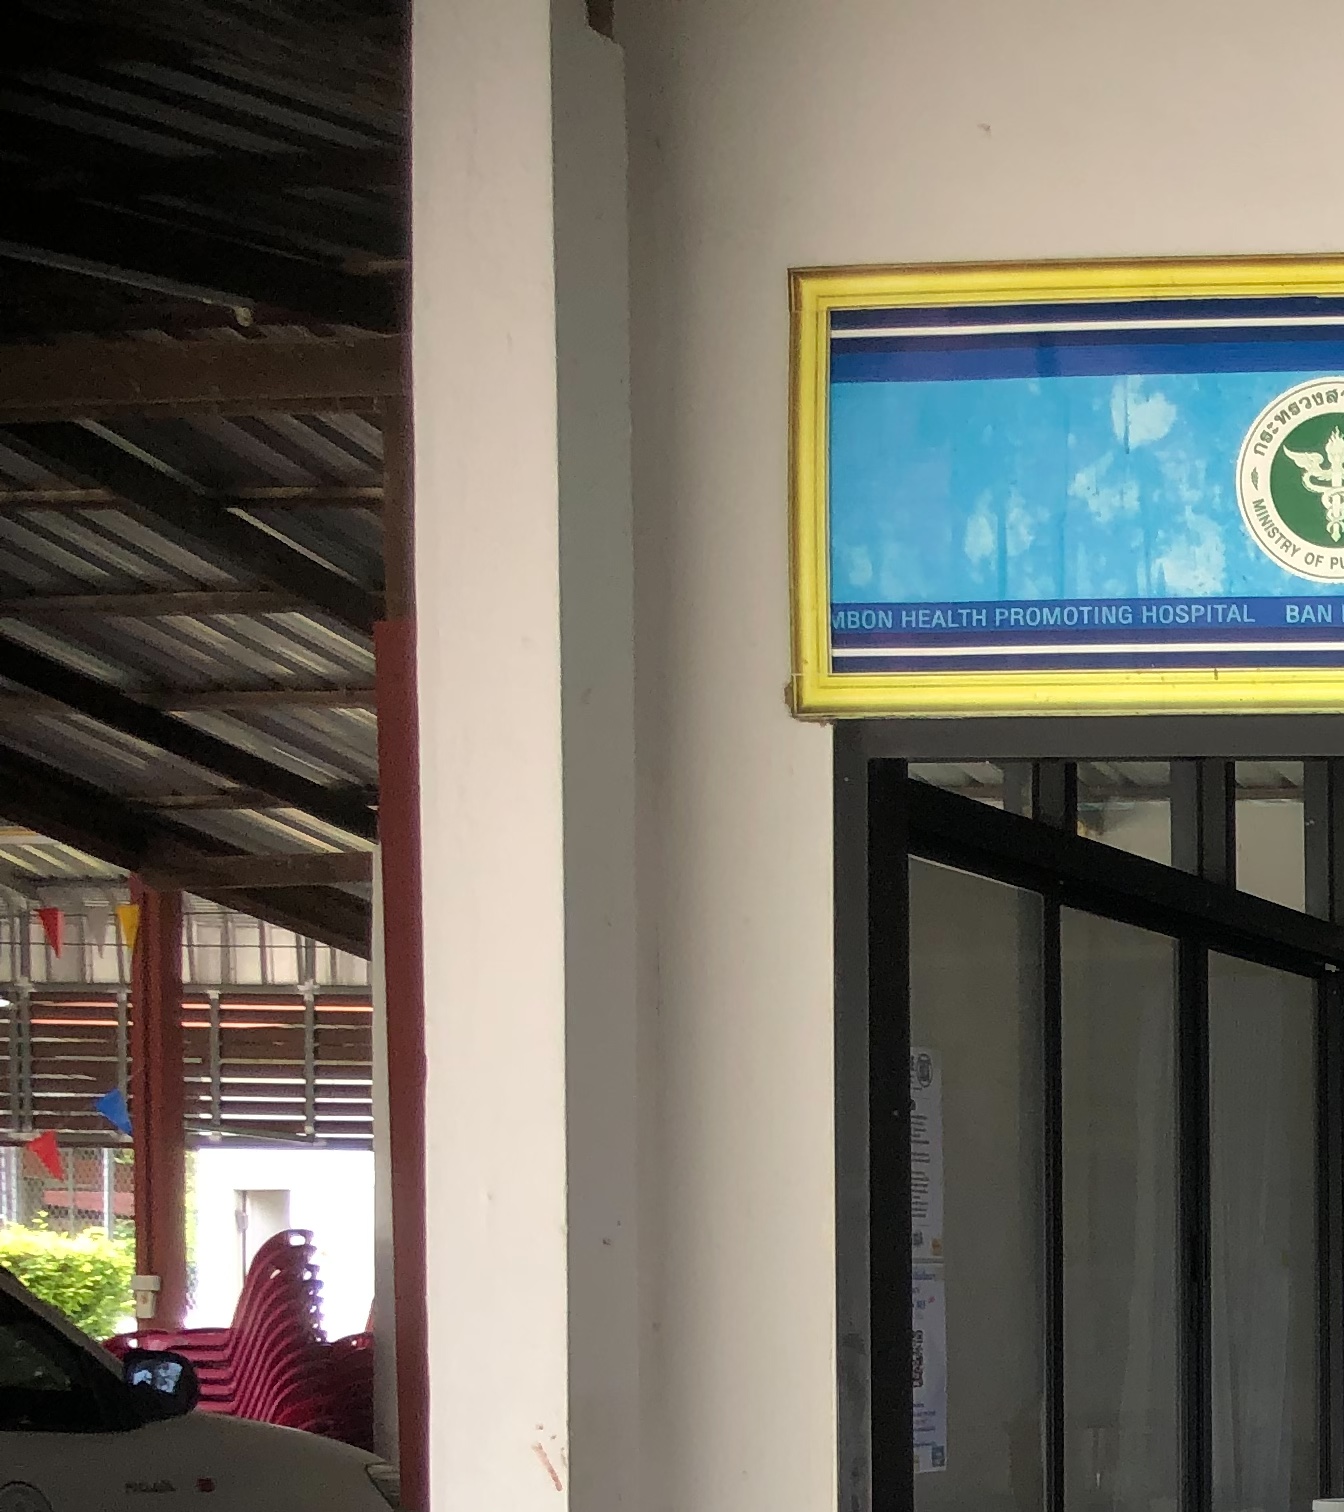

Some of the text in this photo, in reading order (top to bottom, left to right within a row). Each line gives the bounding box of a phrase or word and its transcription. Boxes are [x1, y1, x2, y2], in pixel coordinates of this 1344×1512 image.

[1252, 498, 1301, 557] MINISTRY
[1304, 552, 1325, 569] OF
[832, 603, 1256, 629] MBON HEALTH PROMOTING HOSPITAL
[1285, 603, 1333, 624] BAN
